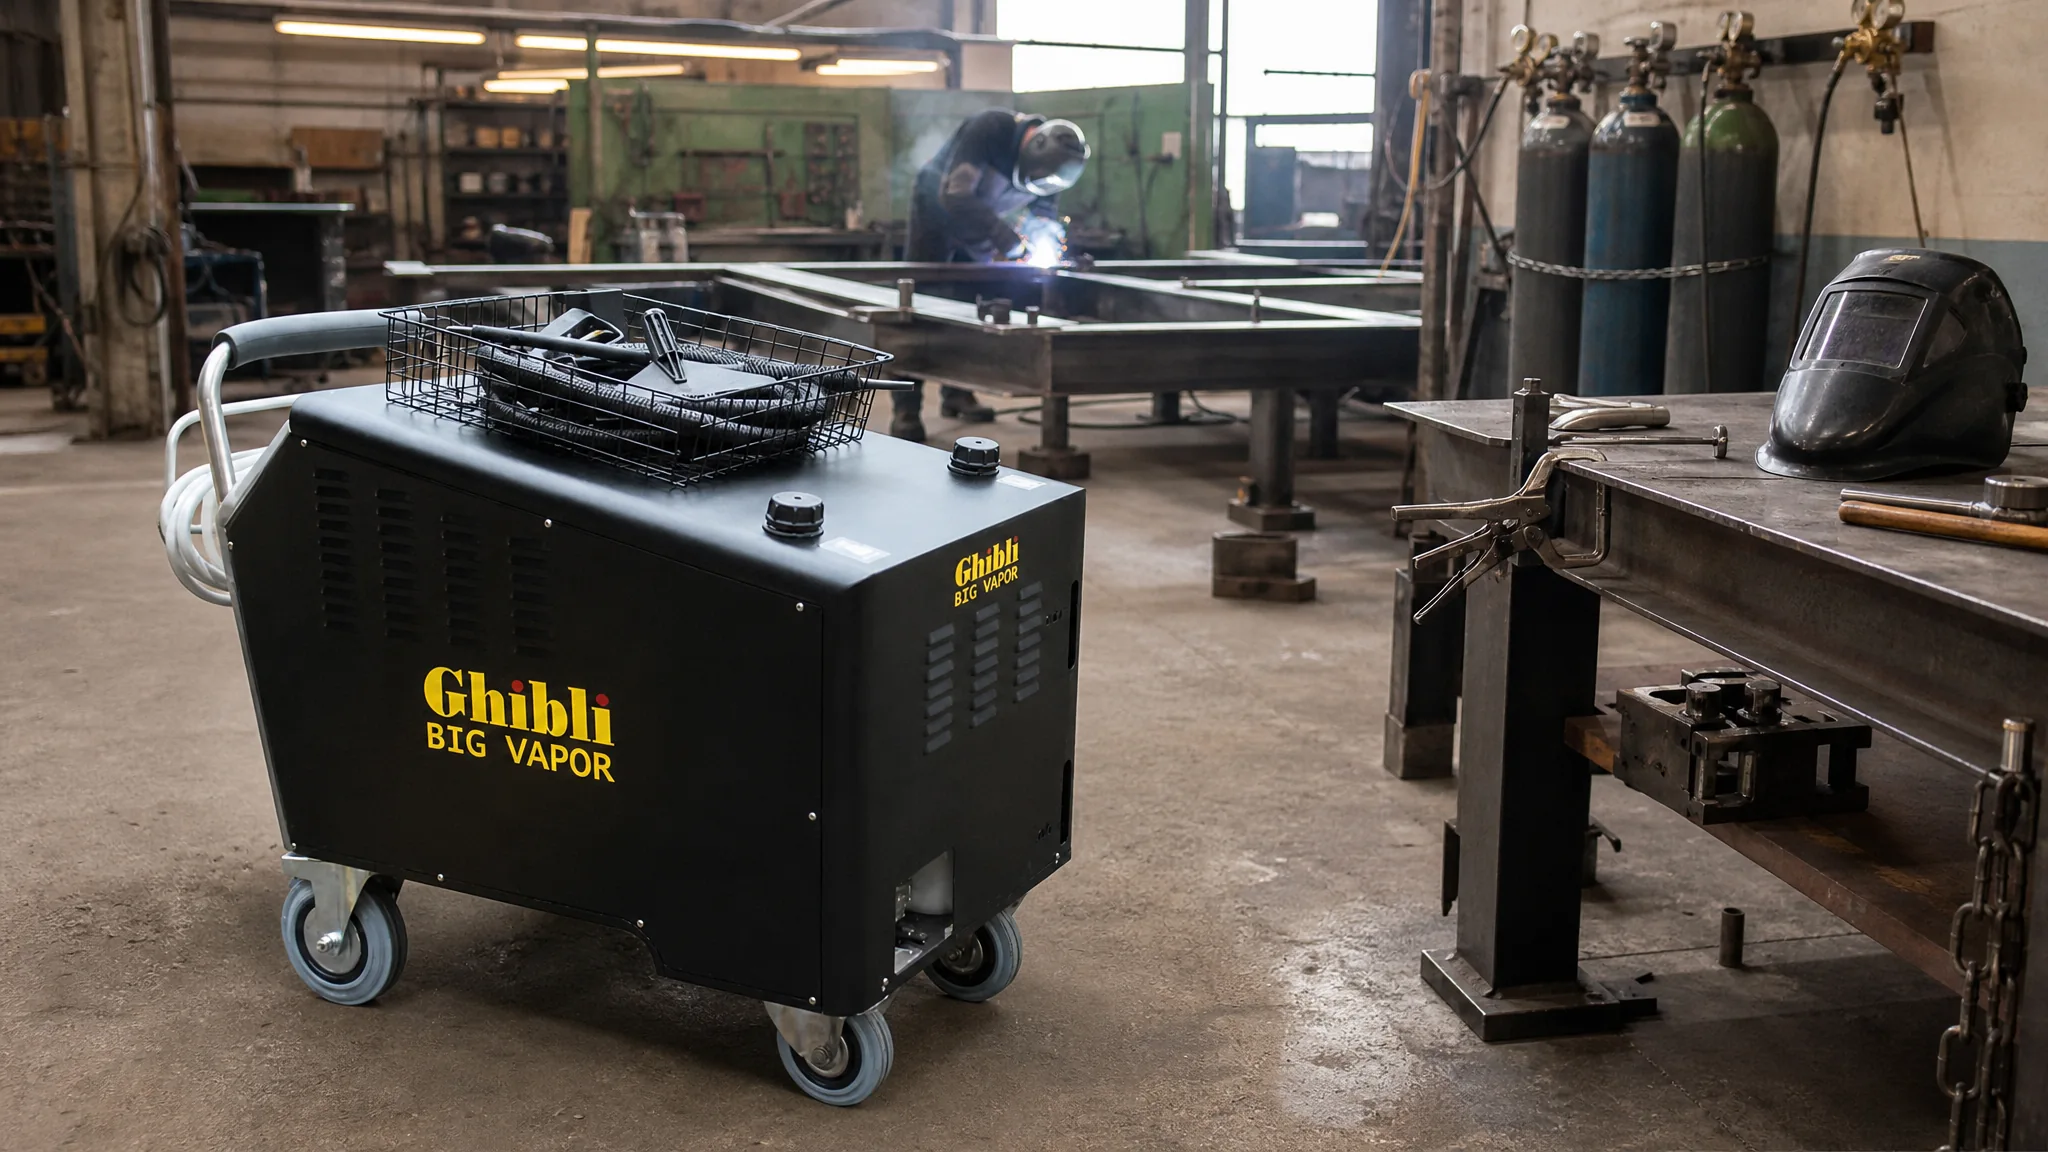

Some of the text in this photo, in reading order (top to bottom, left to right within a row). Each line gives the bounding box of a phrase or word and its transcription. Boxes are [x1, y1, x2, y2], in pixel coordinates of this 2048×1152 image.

[954, 565, 1018, 607] BIG VAPOR
[955, 535, 1019, 587] Ghibli
[423, 666, 615, 747] Ghibli
[426, 721, 615, 783] BIG VAPOR
